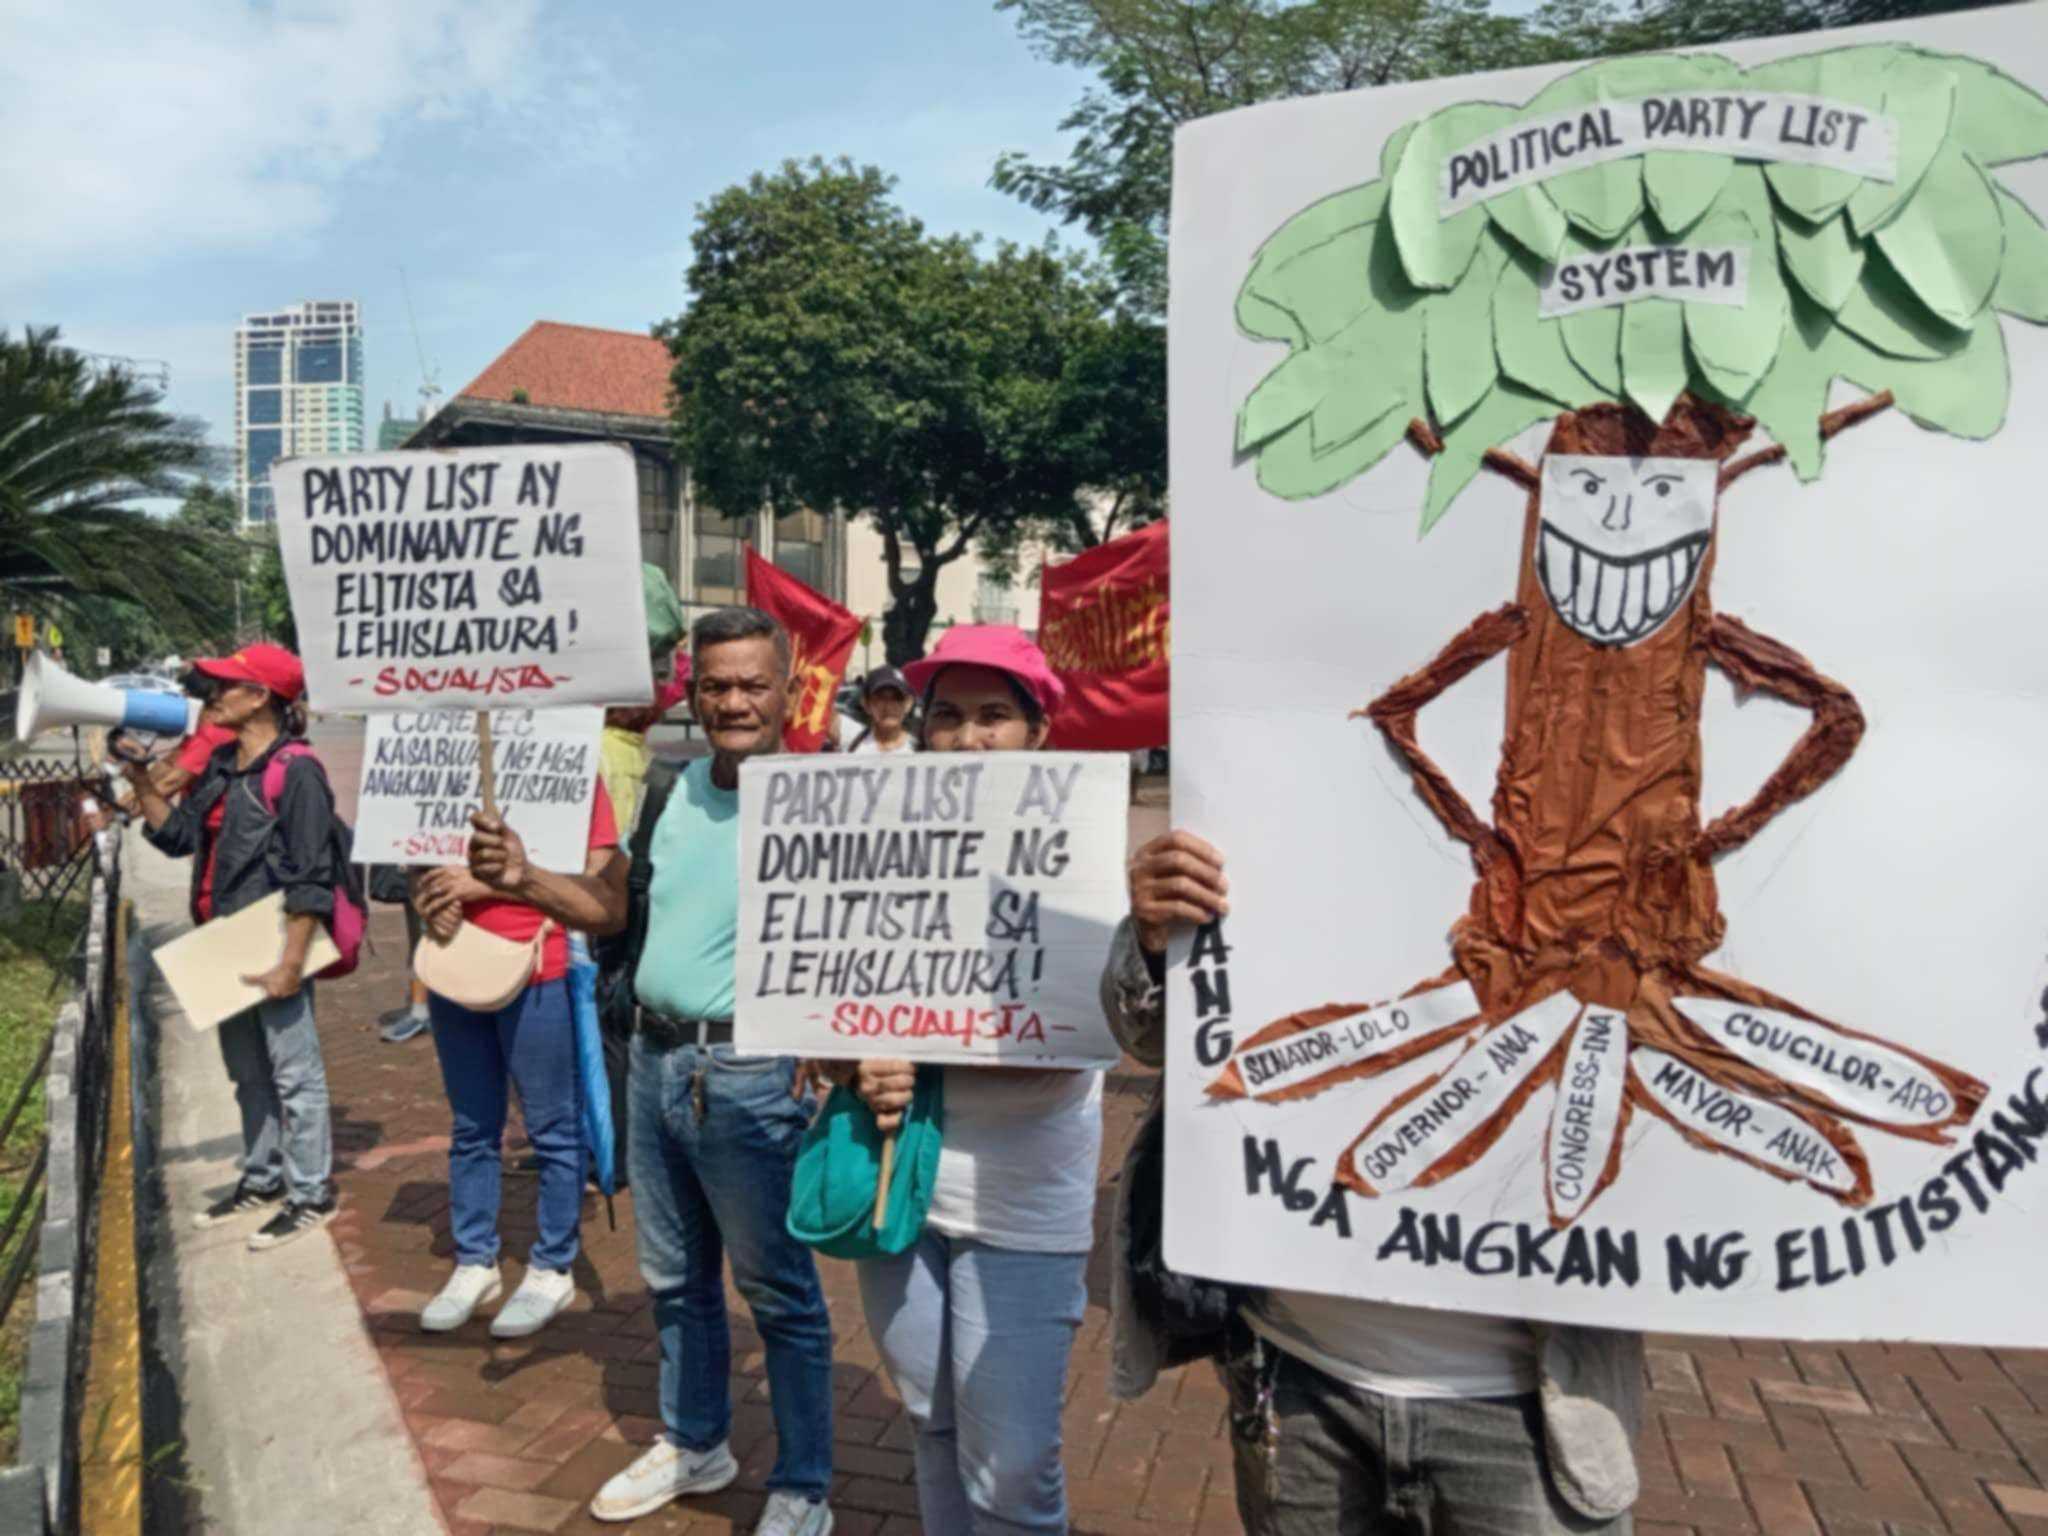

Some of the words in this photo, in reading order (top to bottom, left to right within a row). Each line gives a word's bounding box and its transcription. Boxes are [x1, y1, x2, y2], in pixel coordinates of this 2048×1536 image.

[1449, 108, 1623, 199] POLITICAL
[1642, 97, 1767, 140] PARTY
[1779, 104, 1868, 152] LIST
[1558, 248, 1735, 301] SYSTEM
[302, 465, 413, 518] PARTY
[425, 462, 500, 512] LIST
[516, 460, 562, 509] AY
[311, 516, 520, 565] DOMINANTE
[533, 512, 585, 558] NG
[334, 569, 478, 617] ELITISTA
[497, 566, 542, 603] SA
[336, 608, 579, 659] LEHISLATURA!
[362, 768, 442, 798] ANGKAN
[443, 770, 472, 798] NG
[501, 740, 538, 771] NG
[537, 744, 588, 775] MGA
[762, 767, 891, 827] PARTY
[900, 763, 984, 824] LIST
[1014, 763, 1083, 823] AY
[757, 830, 984, 883] DOMINANTE
[1006, 828, 1070, 877] NG
[760, 890, 952, 944] ELITISTA
[986, 890, 1040, 944] SA
[755, 946, 1045, 999] LEHISLATURA!
[1187, 918, 1234, 1067] ANG
[1243, 1134, 1353, 1238] MGA
[1376, 1206, 1640, 1288] ANGKAN
[1665, 1230, 1751, 1294] NG
